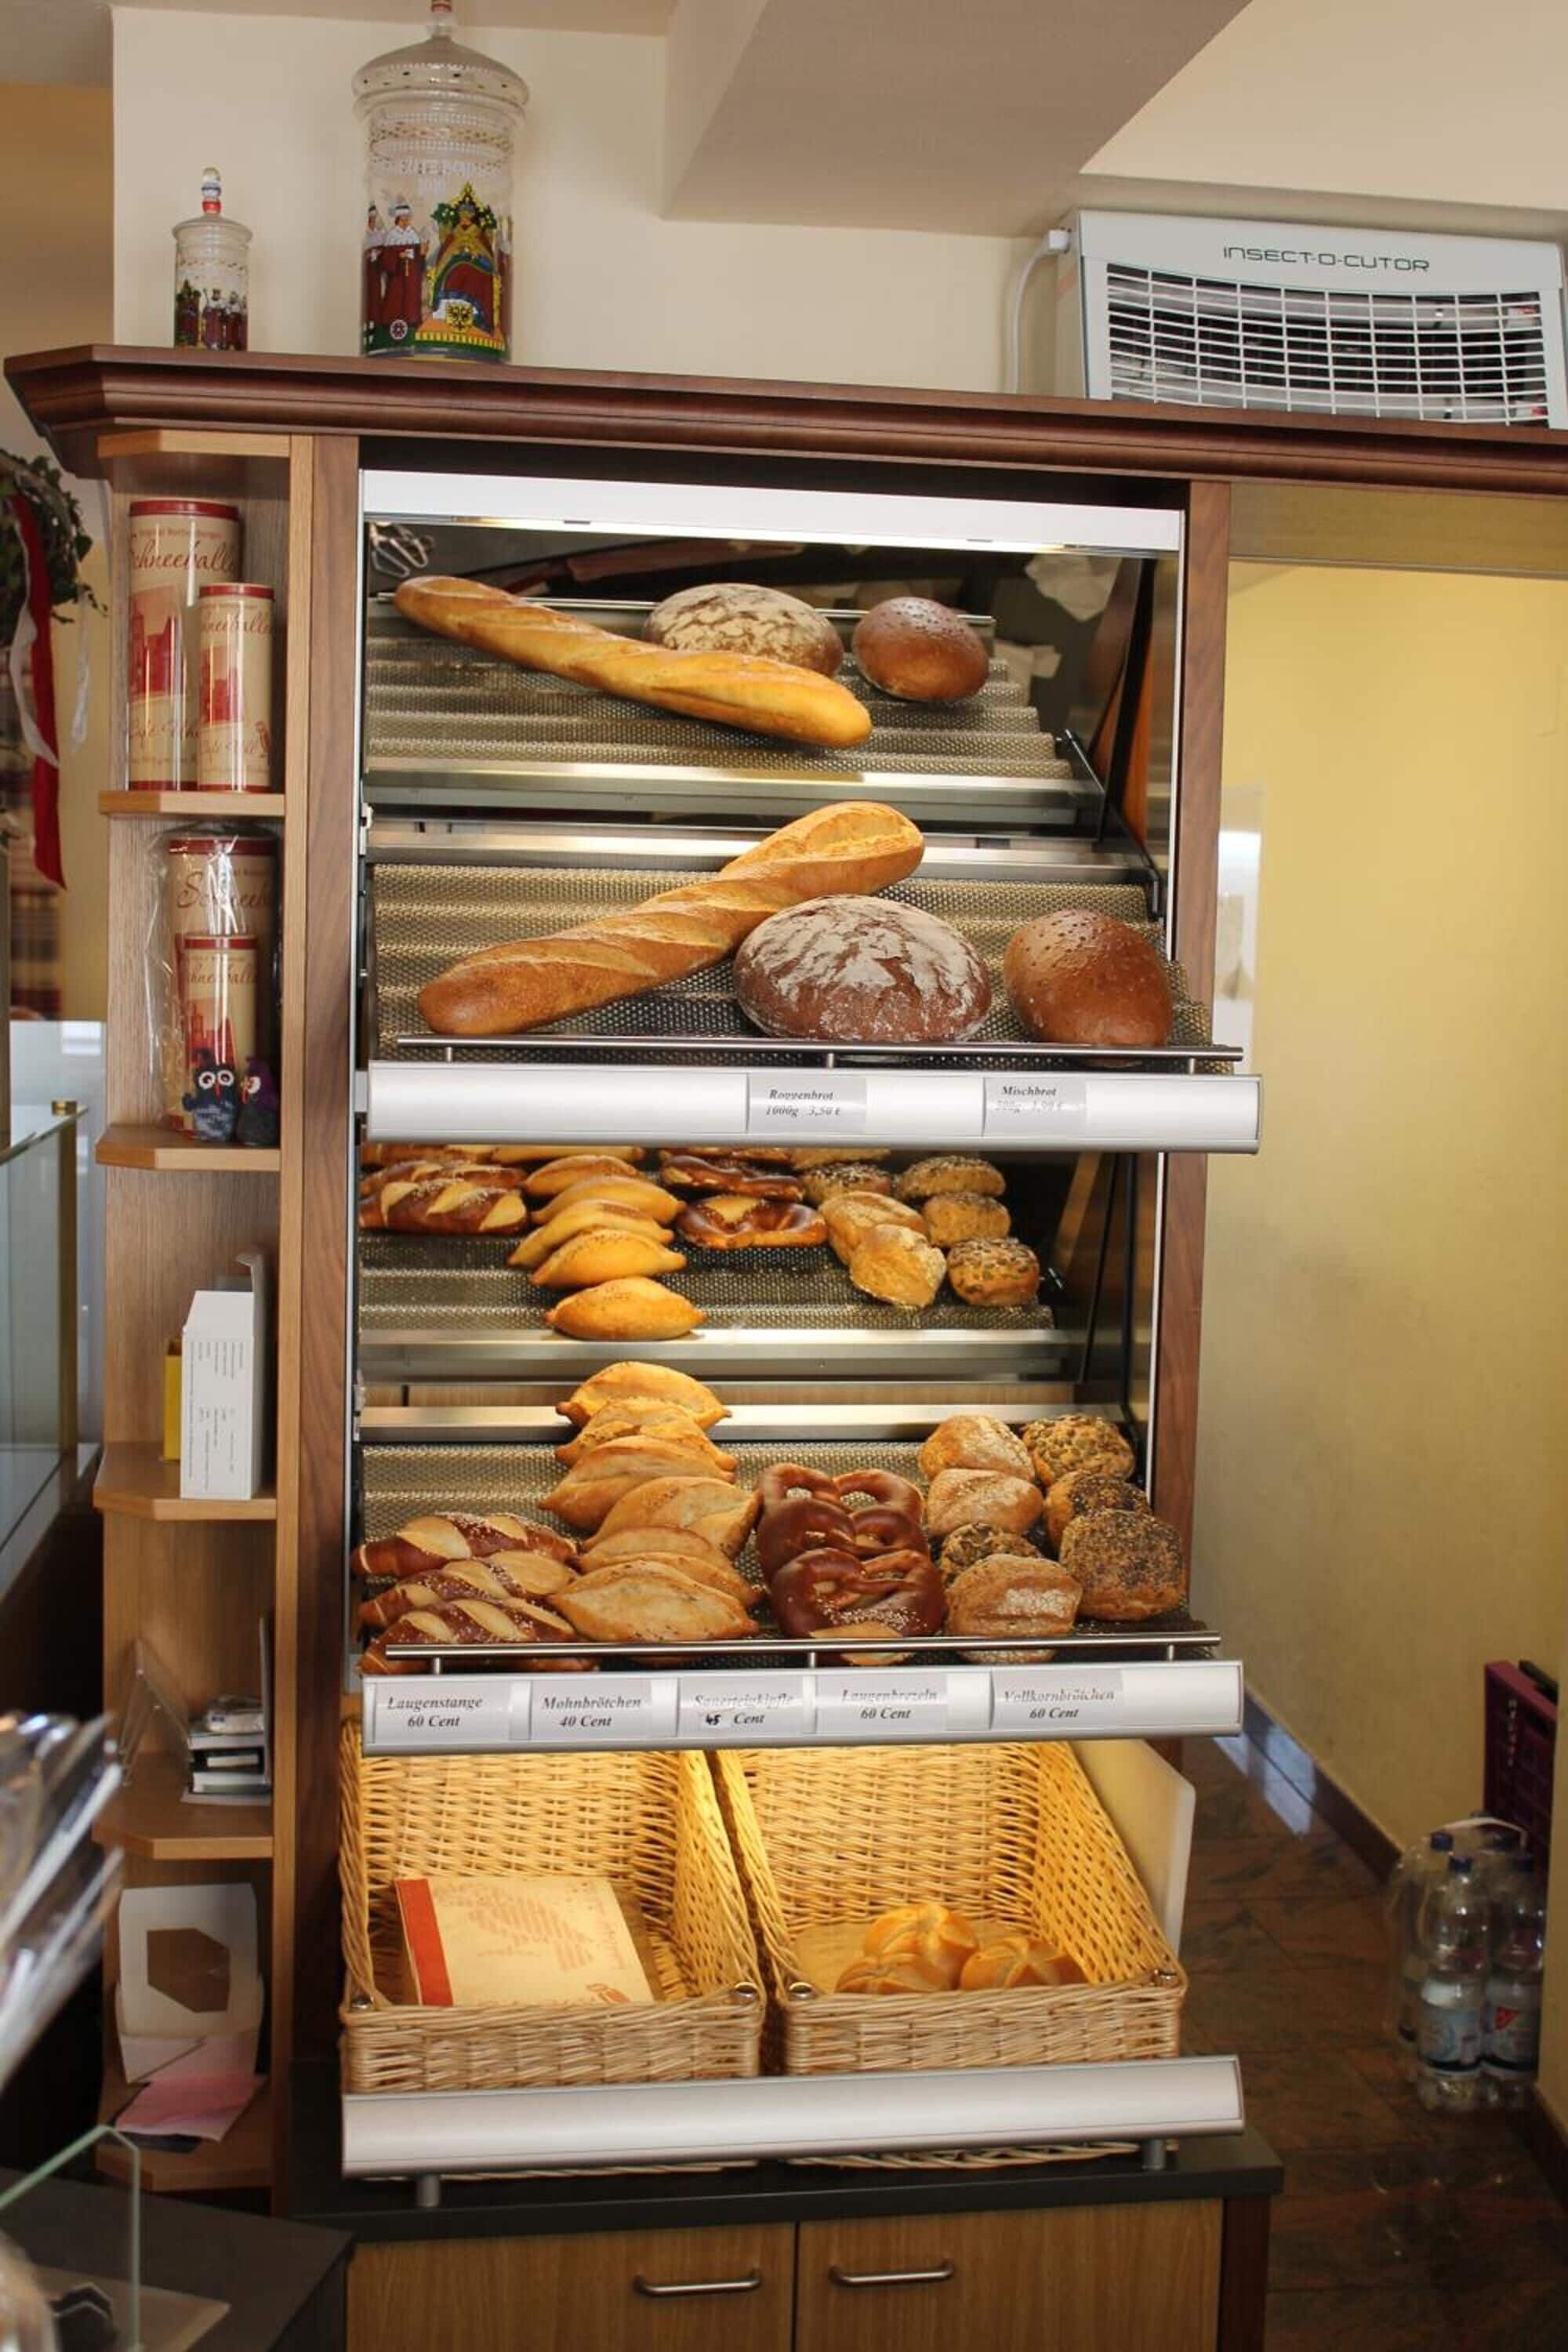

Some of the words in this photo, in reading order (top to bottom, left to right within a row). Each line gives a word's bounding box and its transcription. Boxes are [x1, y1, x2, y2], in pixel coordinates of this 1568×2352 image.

[1224, 245, 1430, 271] INSECT-O-CUTOR
[769, 1089, 834, 1102] Roggenbrot
[1002, 1086, 1057, 1097] Mischbrot
[388, 1696, 483, 1712] Laugenstange
[543, 1694, 641, 1709] Mohnbrötchen
[706, 1714, 721, 1726] 45
[734, 1711, 765, 1725] Cent
[861, 1708, 877, 1719] 60
[880, 1706, 912, 1719] Cent
[1029, 1708, 1046, 1719] 60
[1049, 1706, 1079, 1719] Cent
[408, 1715, 424, 1727] 60
[428, 1714, 461, 1727] Cent
[560, 1715, 576, 1727] 40
[580, 1714, 612, 1727] Cent
